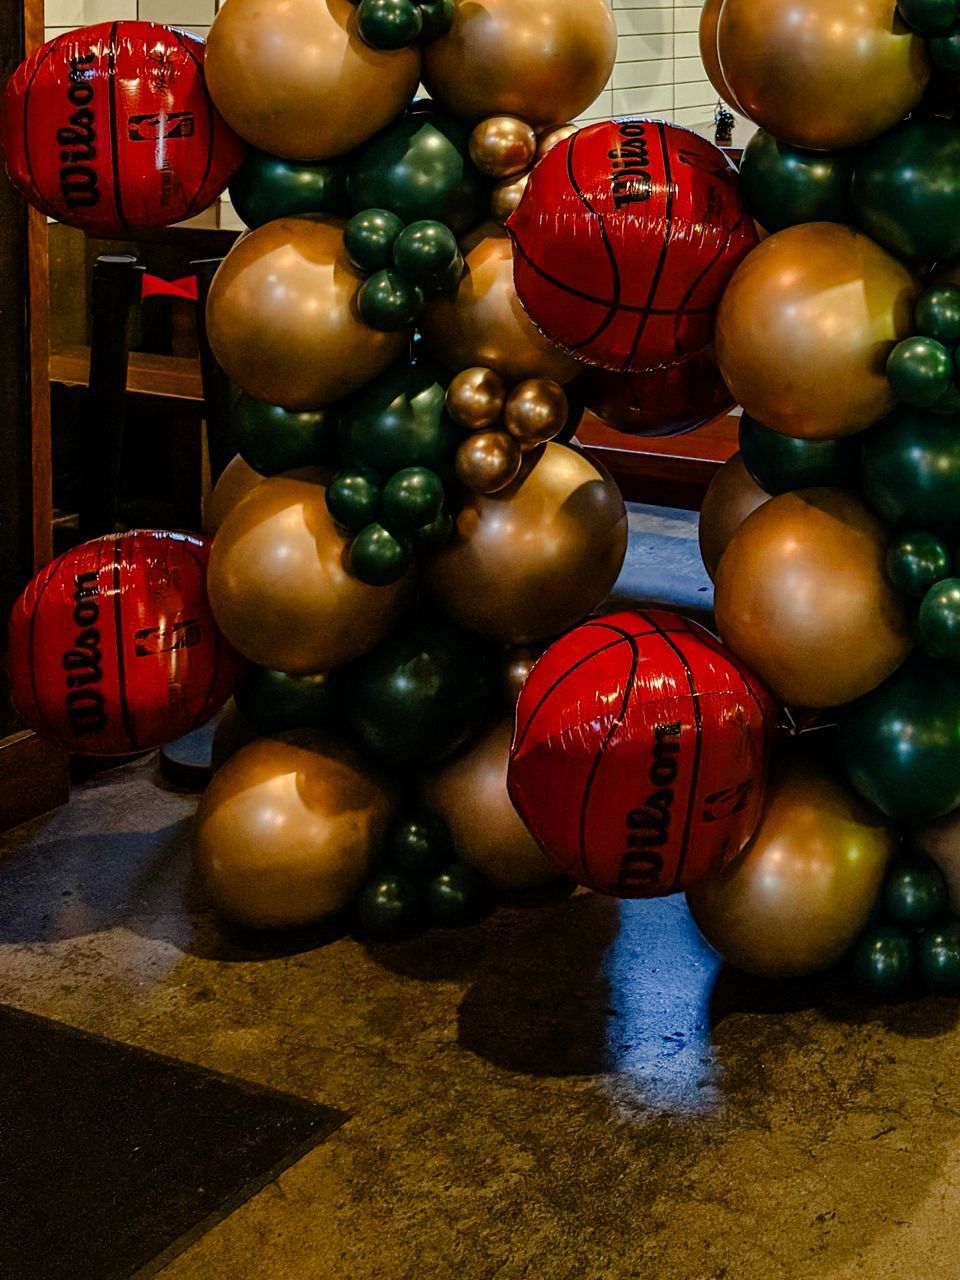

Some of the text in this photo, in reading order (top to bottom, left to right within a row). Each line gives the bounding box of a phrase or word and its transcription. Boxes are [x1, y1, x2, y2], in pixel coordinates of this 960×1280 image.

[608, 122, 652, 210] Wilso
[62, 570, 107, 735] Wilson
[617, 721, 683, 893] Wilson
